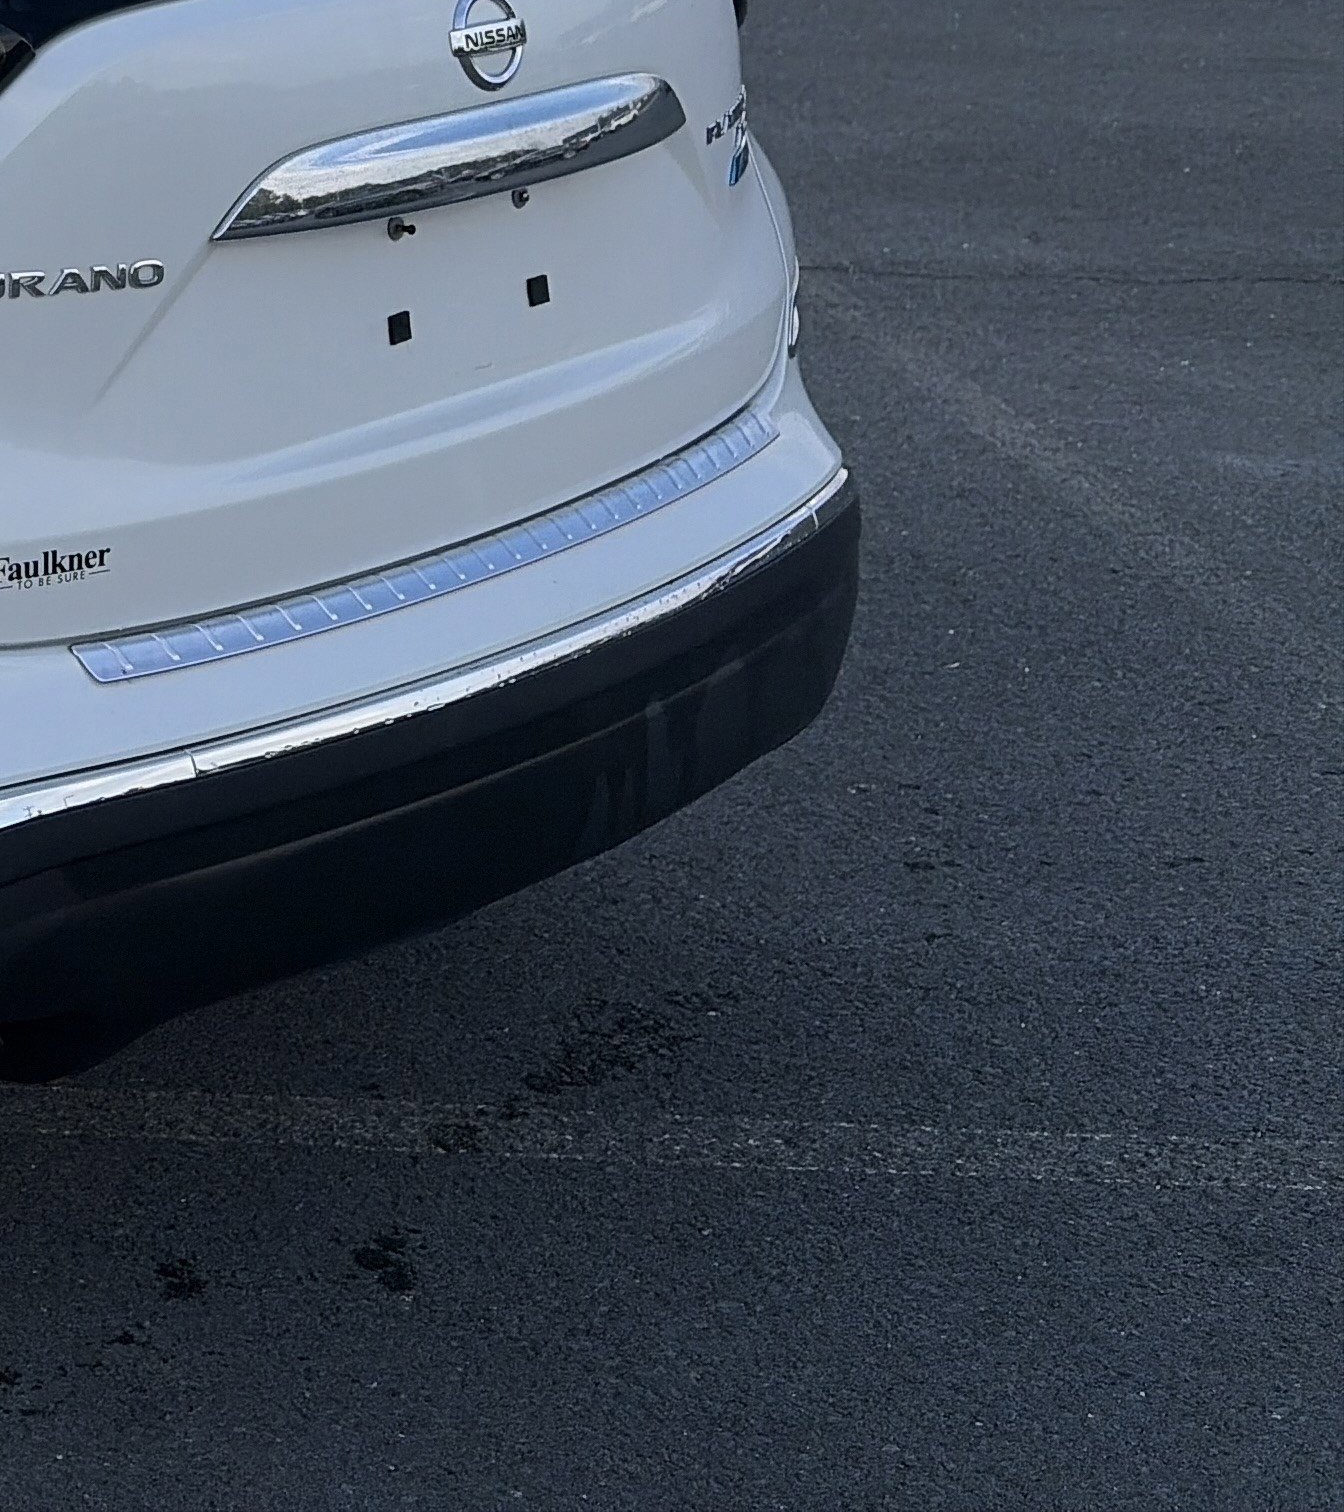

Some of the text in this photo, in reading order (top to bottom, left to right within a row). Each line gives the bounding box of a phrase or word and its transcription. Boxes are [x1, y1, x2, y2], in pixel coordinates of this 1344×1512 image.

[464, 23, 526, 49] NISSAN
[17, 570, 86, 590] TO BE SURE
